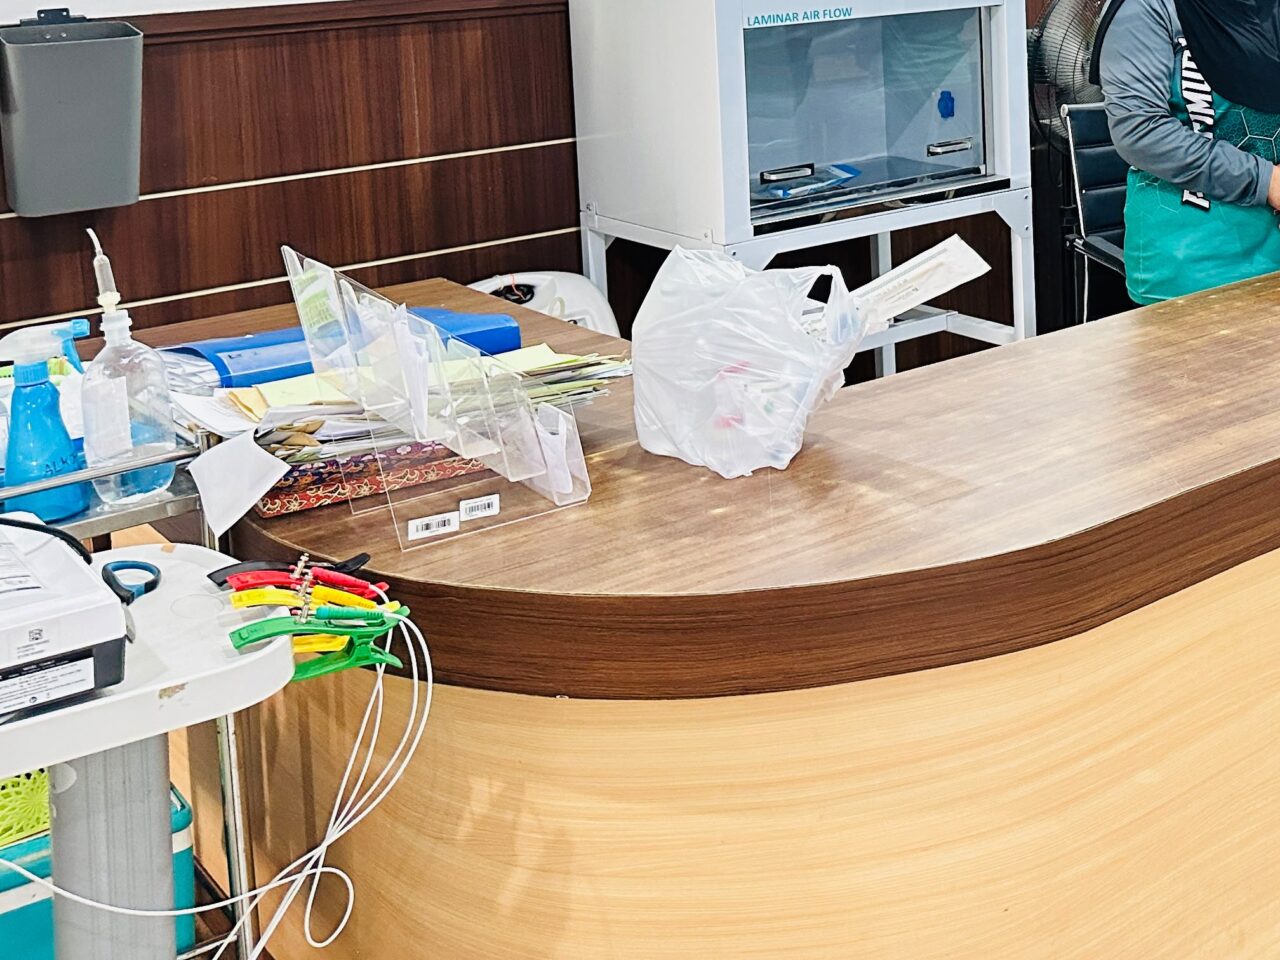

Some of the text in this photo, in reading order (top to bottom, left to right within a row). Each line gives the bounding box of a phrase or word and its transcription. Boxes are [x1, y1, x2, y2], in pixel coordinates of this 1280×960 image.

[747, 7, 853, 27] LAMINAR AIR FLOW
